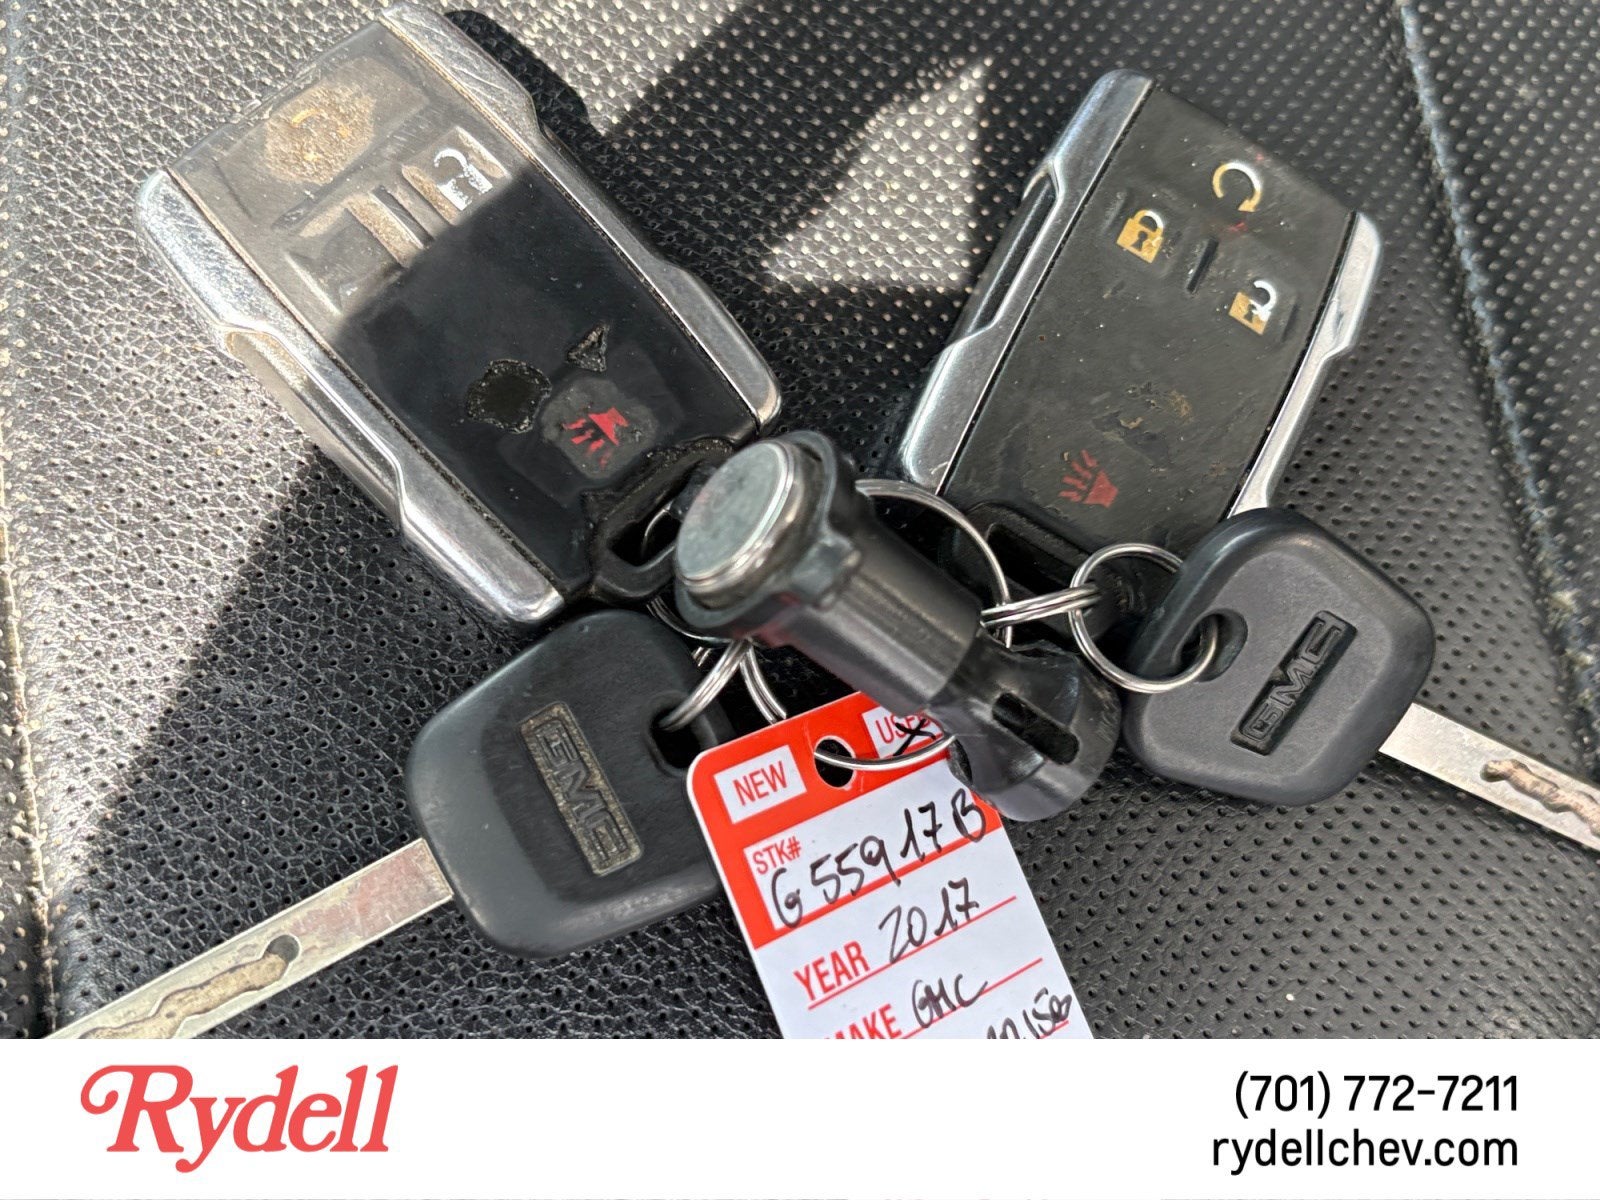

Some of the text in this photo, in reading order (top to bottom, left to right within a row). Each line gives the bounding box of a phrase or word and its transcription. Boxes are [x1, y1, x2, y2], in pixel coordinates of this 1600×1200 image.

[1239, 615, 1343, 742] GMC
[531, 717, 634, 866] GMC
[733, 761, 788, 806] NEW
[753, 836, 802, 875] STK#
[878, 877, 980, 964] 2017
[793, 940, 871, 1001] YEAR
[824, 1003, 903, 1039] AKE
